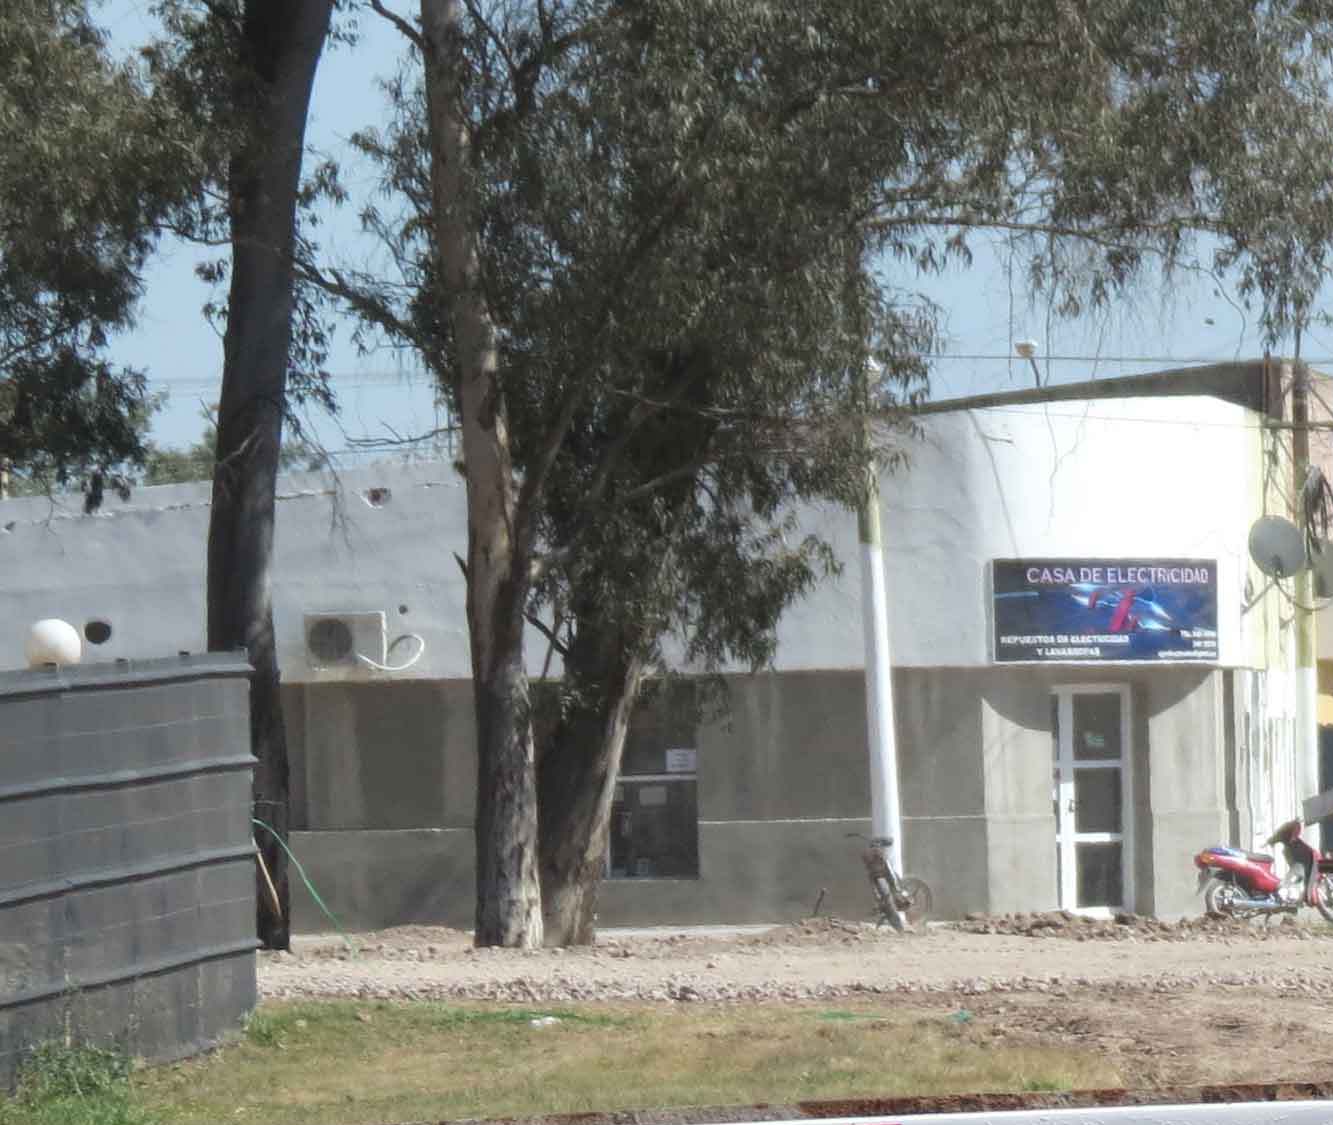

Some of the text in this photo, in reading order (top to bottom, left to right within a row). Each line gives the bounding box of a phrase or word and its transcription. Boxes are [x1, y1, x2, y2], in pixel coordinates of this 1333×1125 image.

[1026, 567, 1208, 584] CASA DE ELECTRICIDAD
